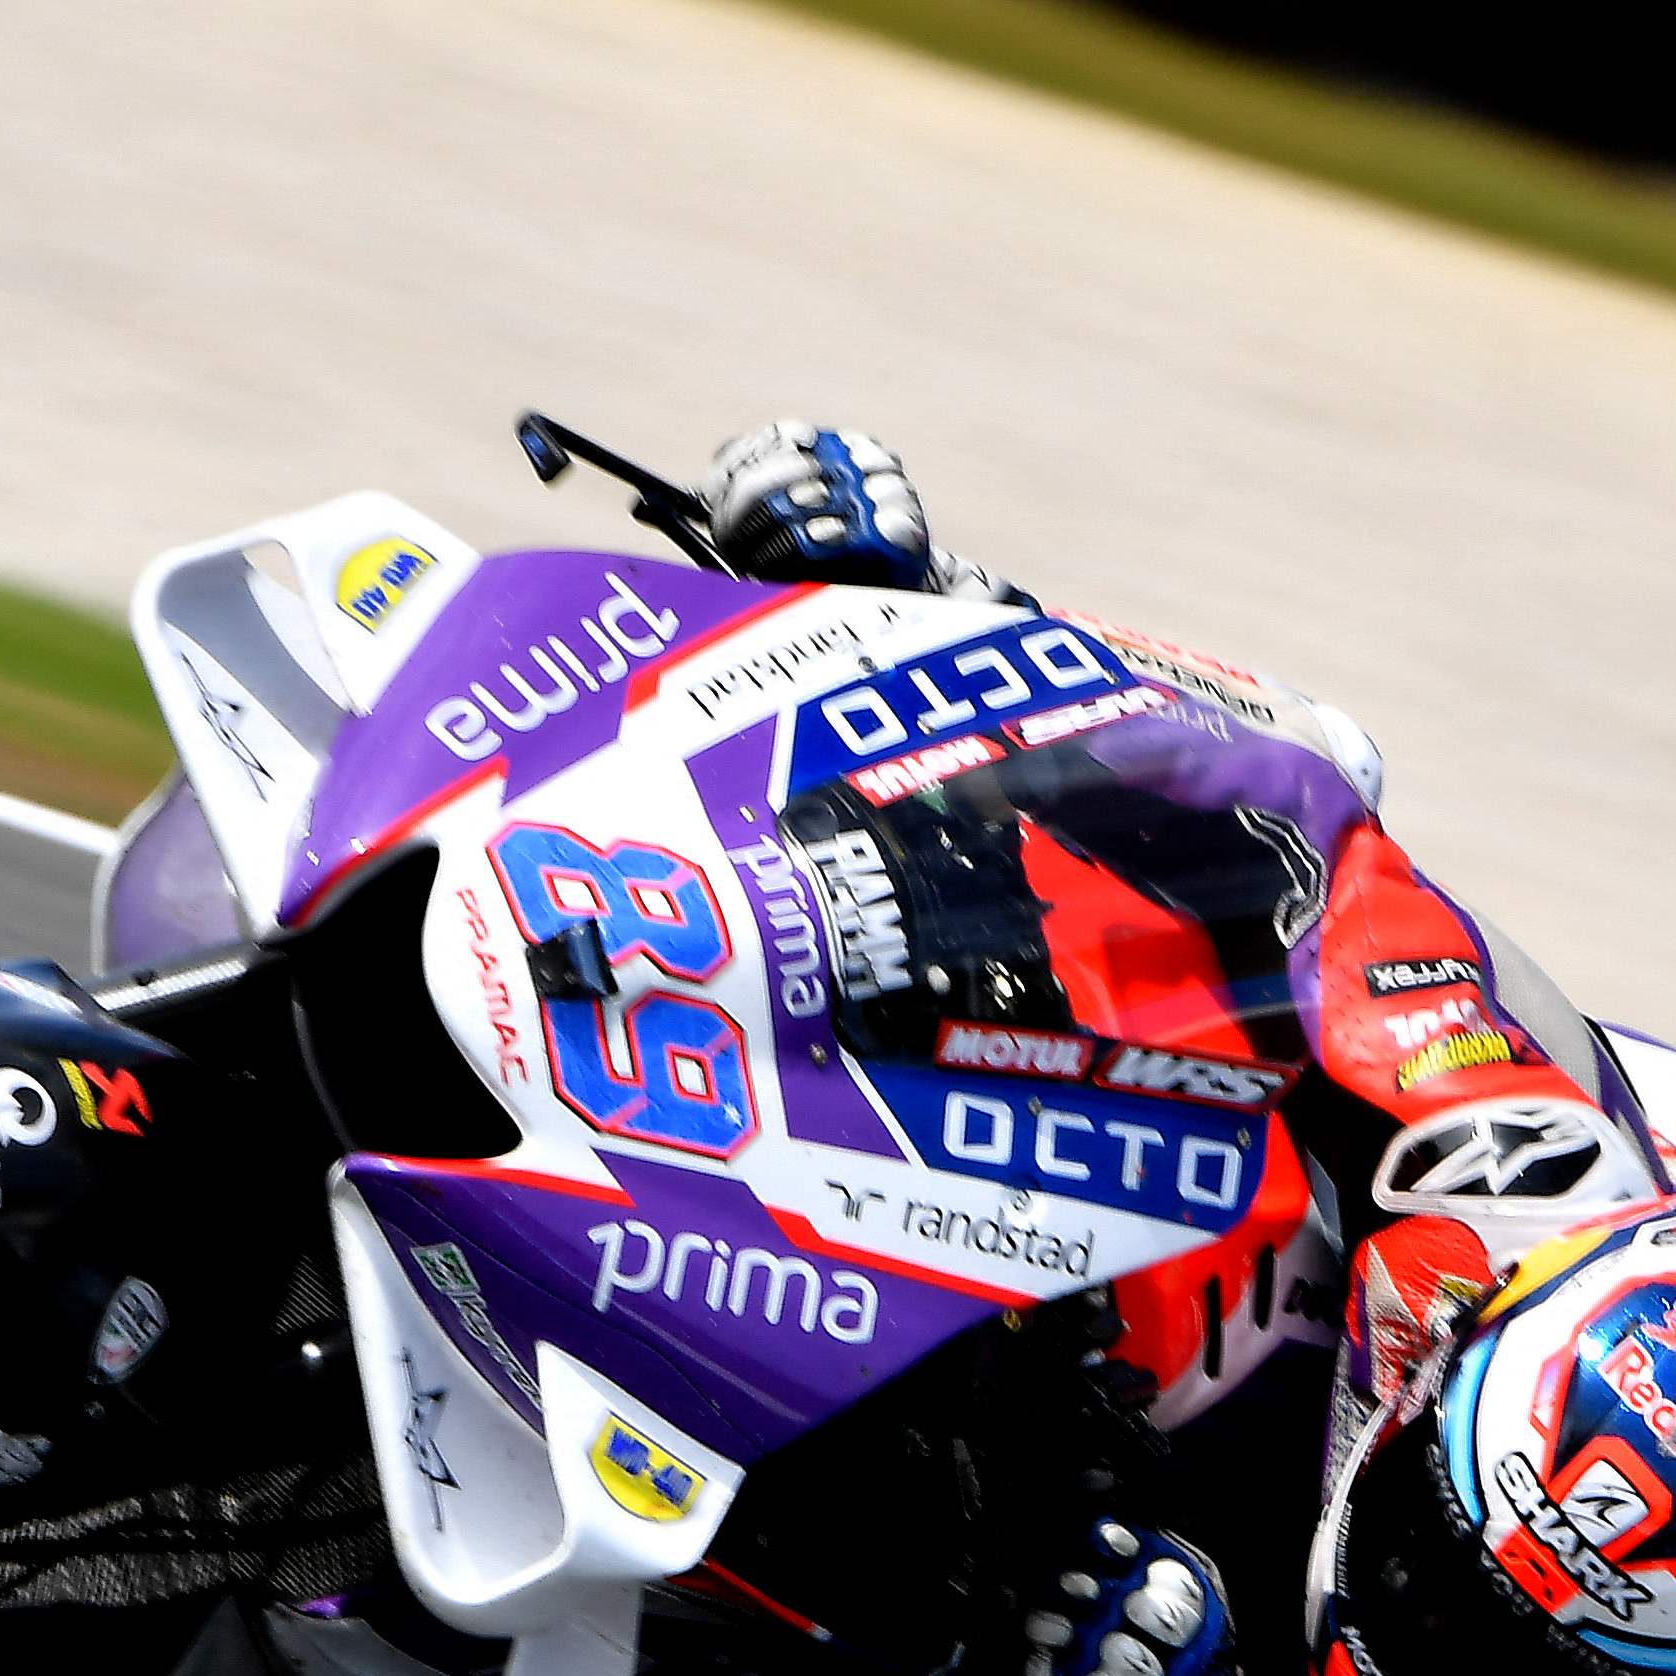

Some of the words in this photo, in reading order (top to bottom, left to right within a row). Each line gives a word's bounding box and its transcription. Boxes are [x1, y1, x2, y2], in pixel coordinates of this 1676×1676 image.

[425, 572, 680, 761] prima
[823, 627, 1118, 756] OCTO
[858, 741, 993, 803] MOTUL
[455, 887, 527, 1087] PRAMAC
[487, 820, 761, 1162] 89
[731, 834, 823, 1019] prima
[941, 1027, 1084, 1075] MOTUL
[942, 1090, 1245, 1206] OCTO
[588, 1221, 878, 1344] prima
[902, 1200, 1094, 1278] randstad
[1496, 1453, 1655, 1622] SHARK
